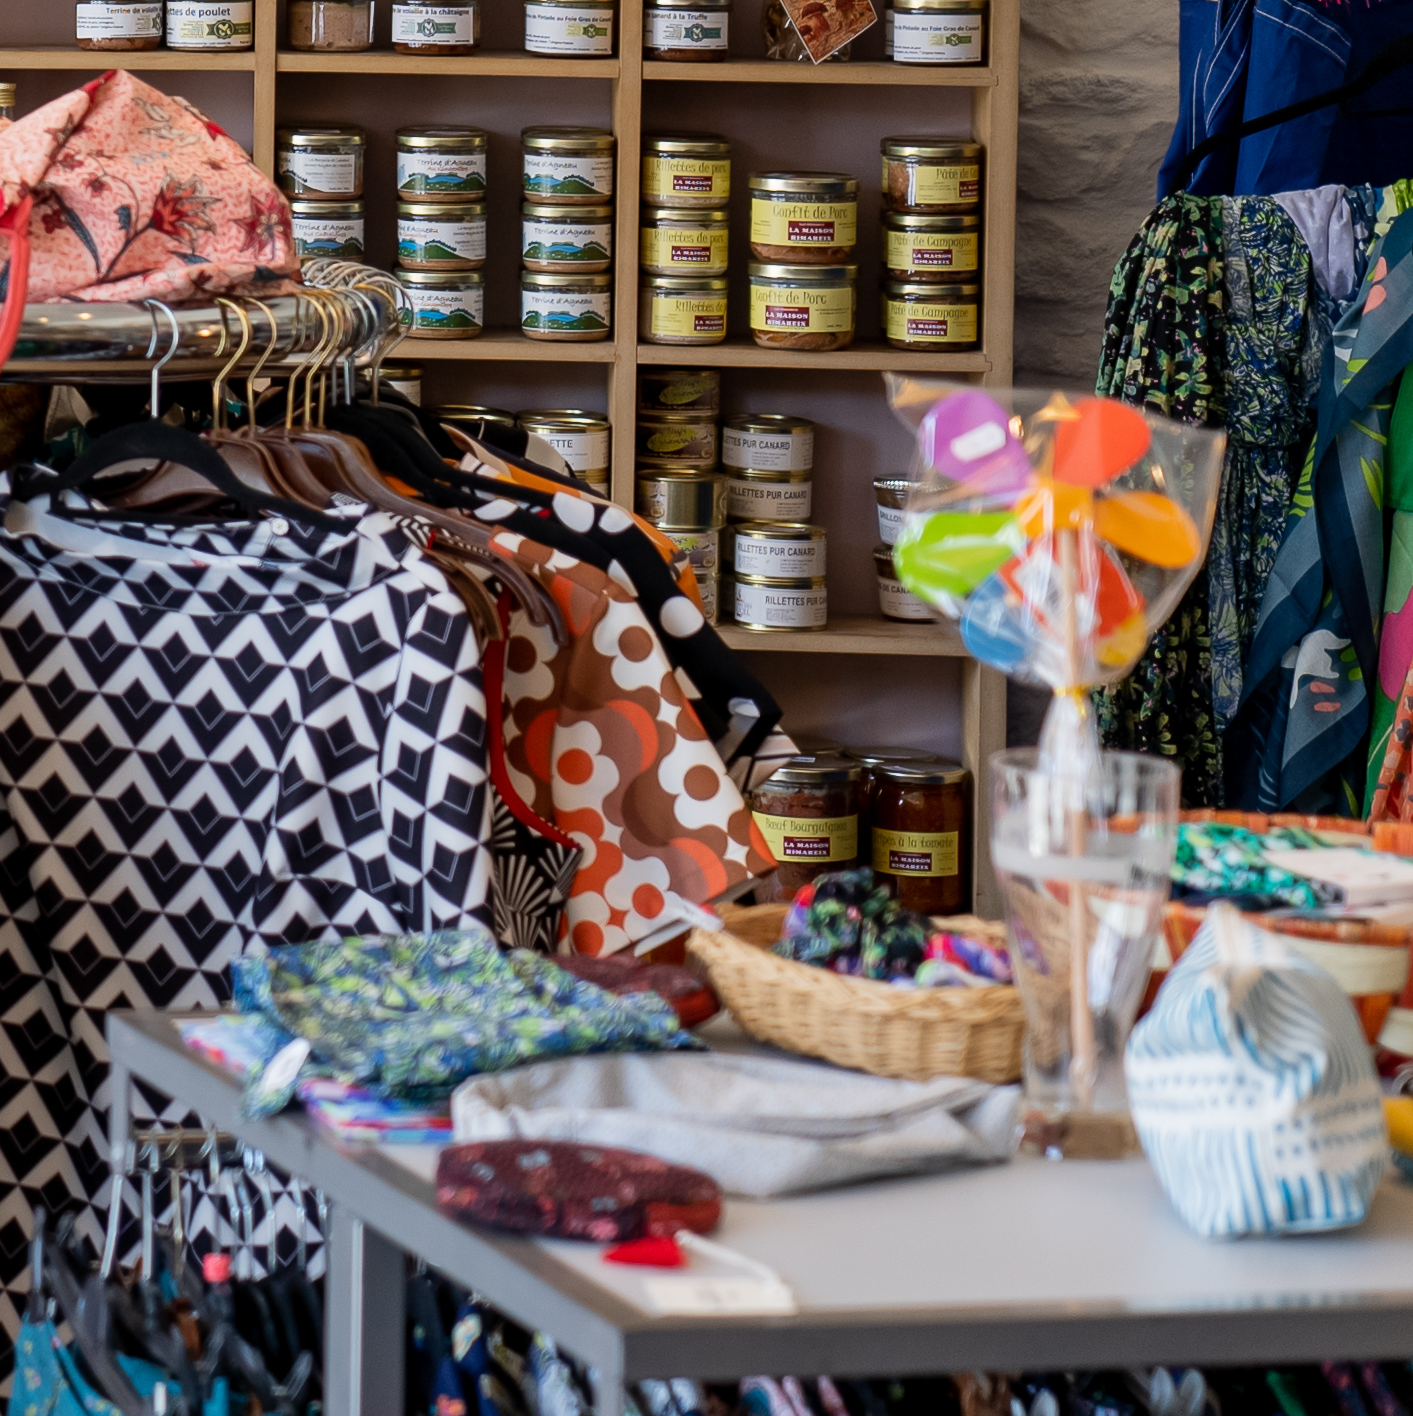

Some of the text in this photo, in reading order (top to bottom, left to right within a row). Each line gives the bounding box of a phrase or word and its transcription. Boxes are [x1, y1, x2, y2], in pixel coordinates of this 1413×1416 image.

[185, 7, 196, 16] de
[199, 7, 231, 18] poulet
[439, 8, 470, 16] châtaigne
[656, 159, 726, 175] Rillettes de porc
[936, 167, 969, 180] Pâté de
[773, 204, 848, 219] Confit de Porc
[294, 223, 355, 233] Terrine d'Agneau
[534, 227, 596, 238] Terrine d'Agneau
[654, 230, 723, 246] Rillettes de porc
[894, 234, 972, 249] Pâté de Campagne
[531, 296, 593, 307] Terrine d'Agneau
[755, 290, 827, 305] Confit de Porc
[675, 299, 723, 313] Rillettes de
[891, 303, 969, 320] Pâté de Campagne
[729, 486, 807, 499] RILLETTES PUR CANARD
[738, 543, 815, 556] RILLETTES PUR CANARD
[765, 595, 818, 606] RILLETTES PUR
[765, 817, 847, 834] Bœuf Bourguignon
[898, 836, 904, 846] à
[908, 836, 917, 848] la
[920, 836, 954, 849] tomate
